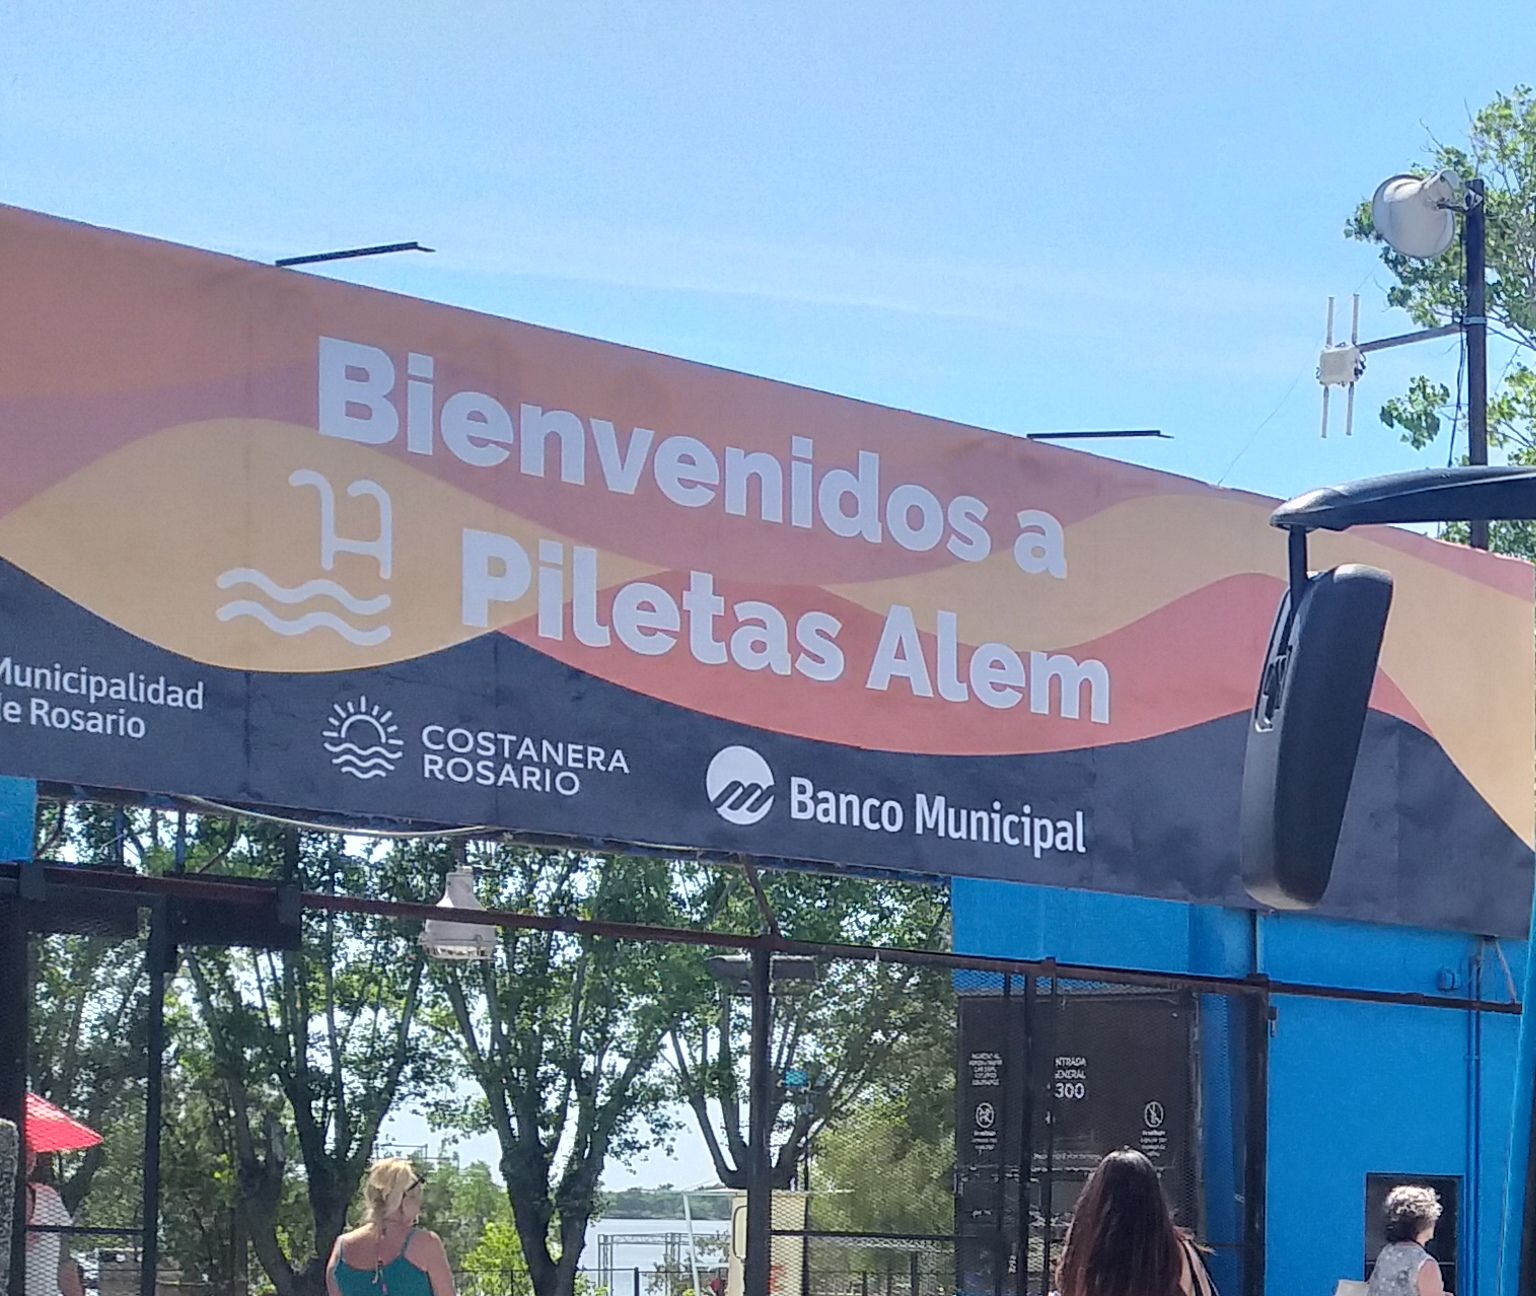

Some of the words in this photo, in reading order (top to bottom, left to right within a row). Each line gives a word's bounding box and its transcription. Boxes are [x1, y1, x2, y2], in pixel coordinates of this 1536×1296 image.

[318, 336, 991, 563] Bienvenidos
[1013, 509, 1067, 579] a
[461, 528, 844, 683] Piletas
[865, 604, 1110, 725] Alem
[0, 692, 22, 724] e
[30, 698, 146, 739] Rosario
[422, 725, 629, 774] COSTANERA
[422, 754, 581, 797] ROSARIO
[791, 777, 902, 832] Banco
[915, 794, 1086, 858] Municipal
